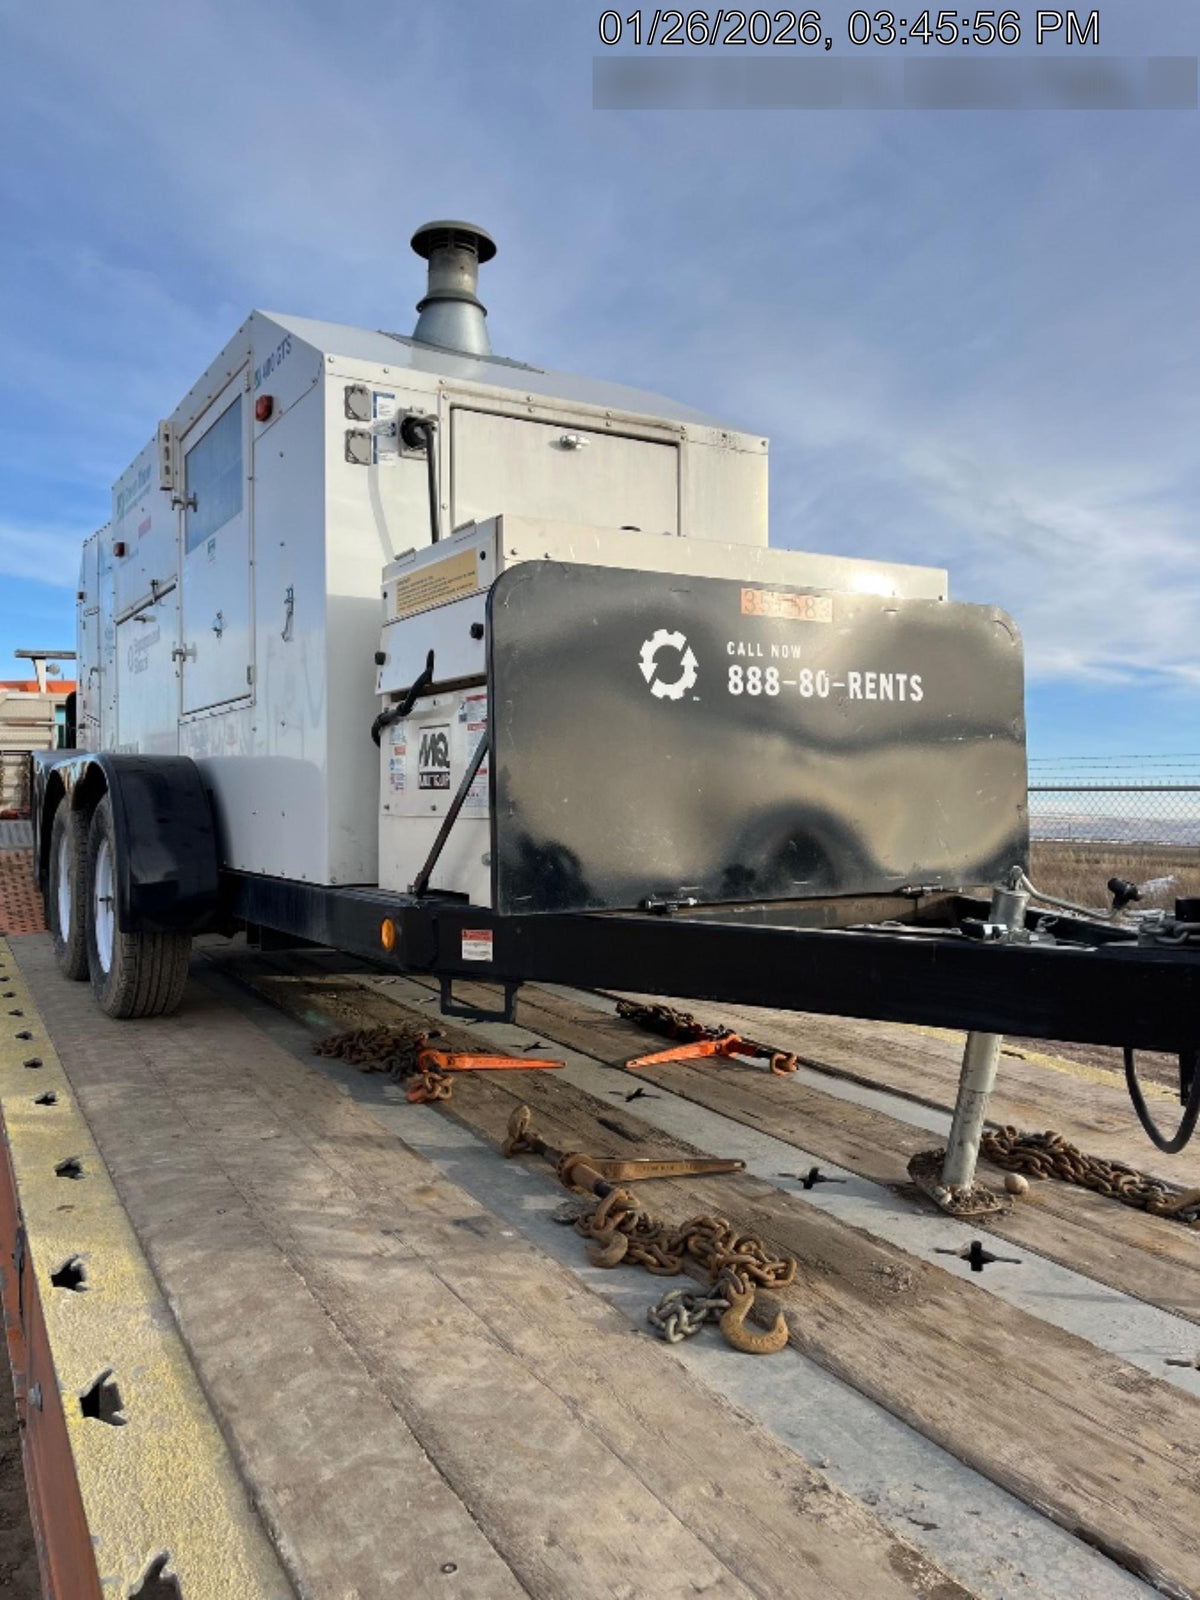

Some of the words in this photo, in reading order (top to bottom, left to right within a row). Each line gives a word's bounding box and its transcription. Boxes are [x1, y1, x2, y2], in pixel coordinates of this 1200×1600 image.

[726, 641, 763, 657] CALL
[771, 645, 801, 659] NOW
[727, 664, 924, 702] 888-80-RENTS
